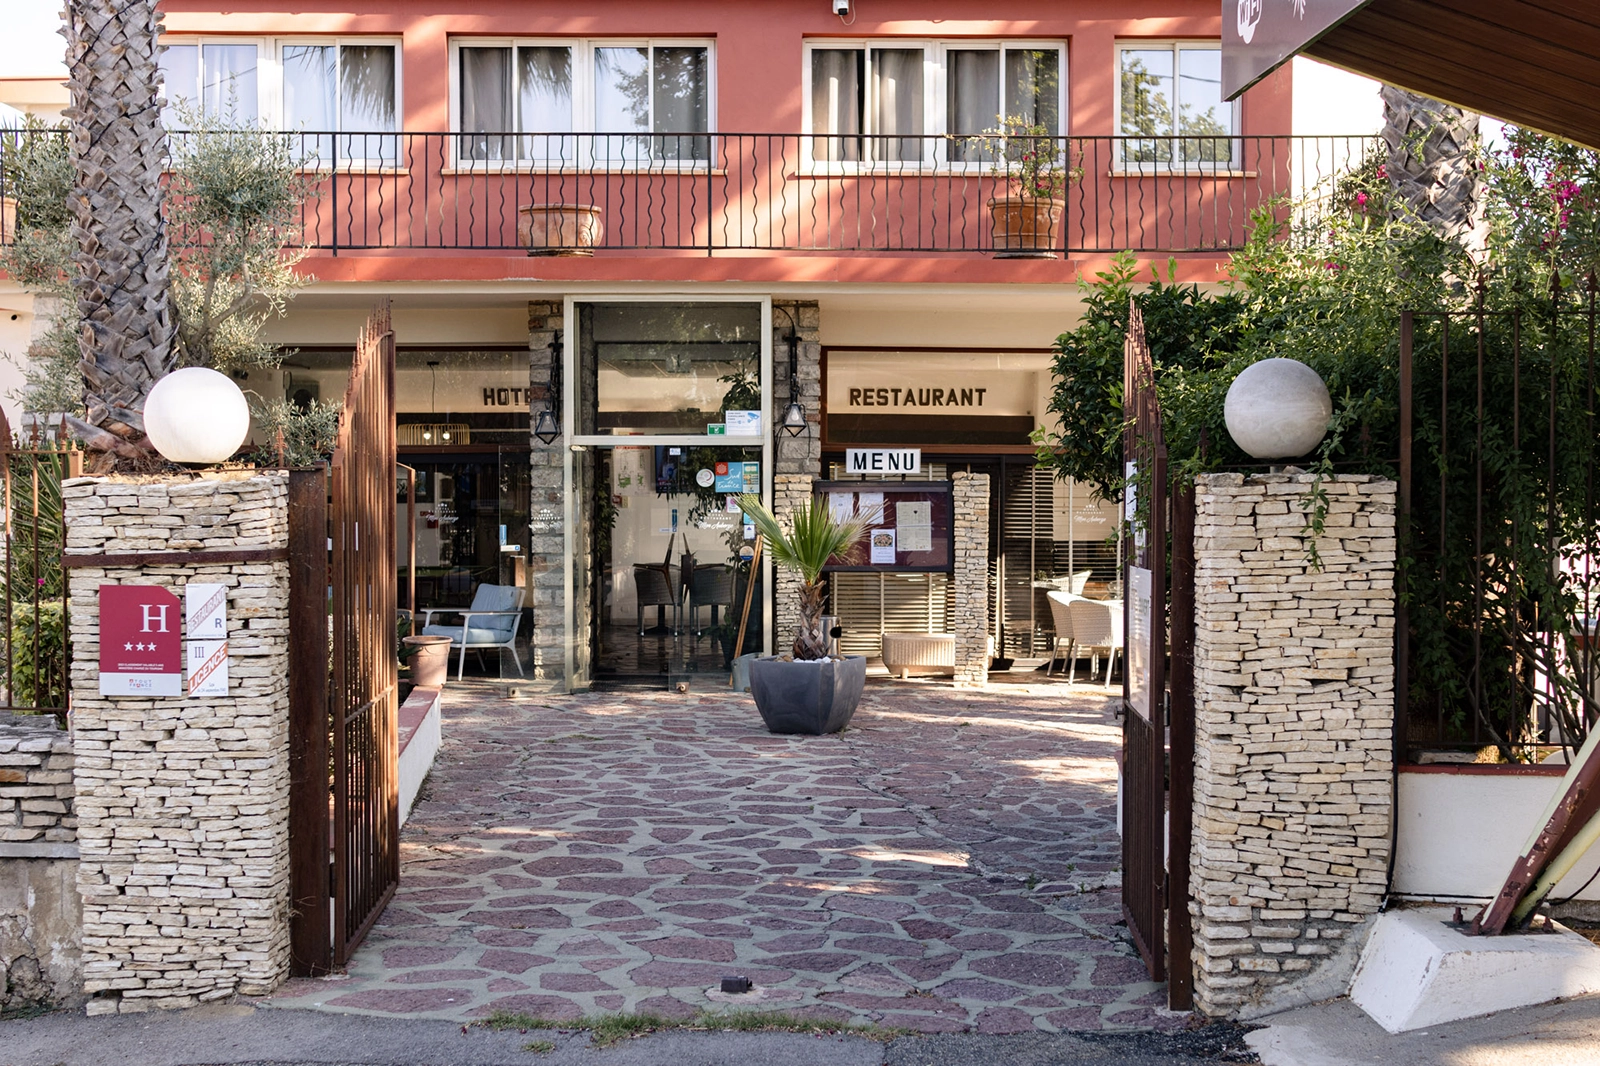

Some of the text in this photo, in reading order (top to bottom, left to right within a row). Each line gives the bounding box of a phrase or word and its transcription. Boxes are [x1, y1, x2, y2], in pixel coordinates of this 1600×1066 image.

[849, 388, 986, 406] RESTAURANT
[853, 452, 914, 471] MENU
[139, 604, 170, 632] H
[215, 618, 222, 628] R
[194, 646, 204, 658] III
[190, 644, 226, 692] LICENCE
